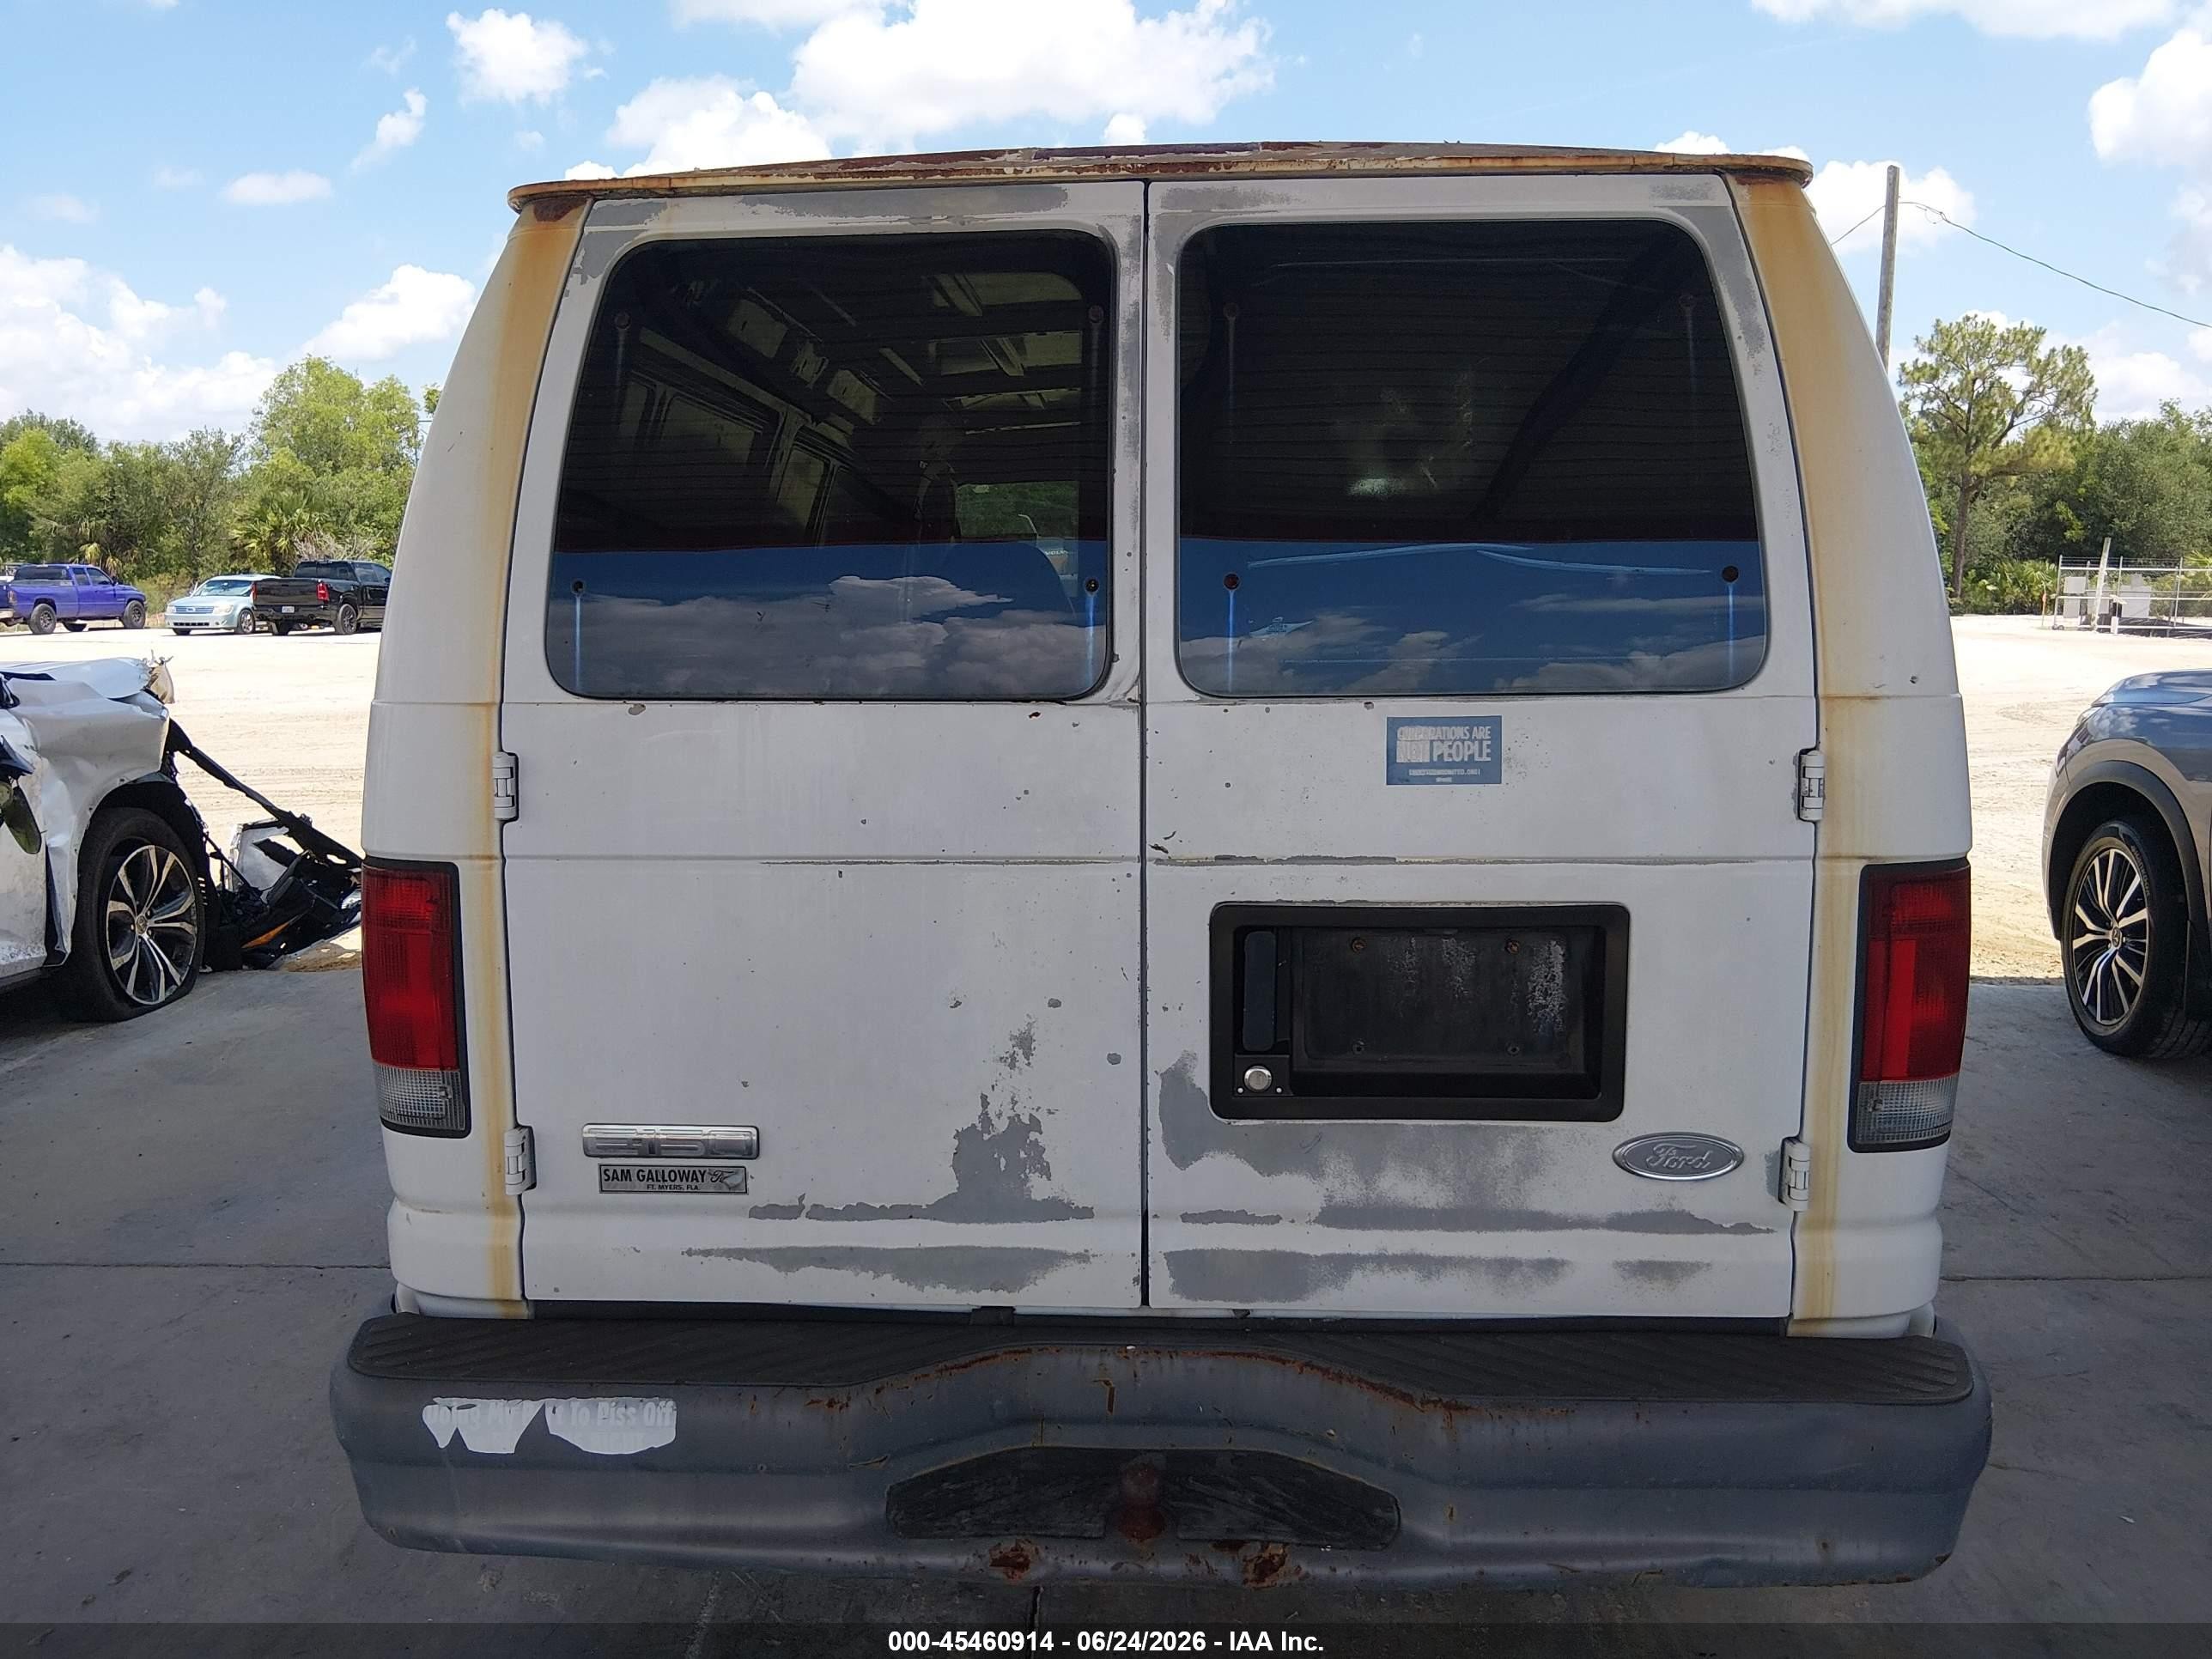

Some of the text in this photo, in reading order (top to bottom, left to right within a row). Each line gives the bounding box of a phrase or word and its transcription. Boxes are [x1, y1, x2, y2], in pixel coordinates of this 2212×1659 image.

[1472, 726, 1491, 740] ARE
[1432, 740, 1492, 762] PEOPLE
[1646, 1142, 1713, 1169] Ford
[604, 1169, 632, 1182] SAM
[636, 1169, 707, 1183] GALLOWAY
[597, 1401, 636, 1426] Piss
[643, 1401, 674, 1426] Off
